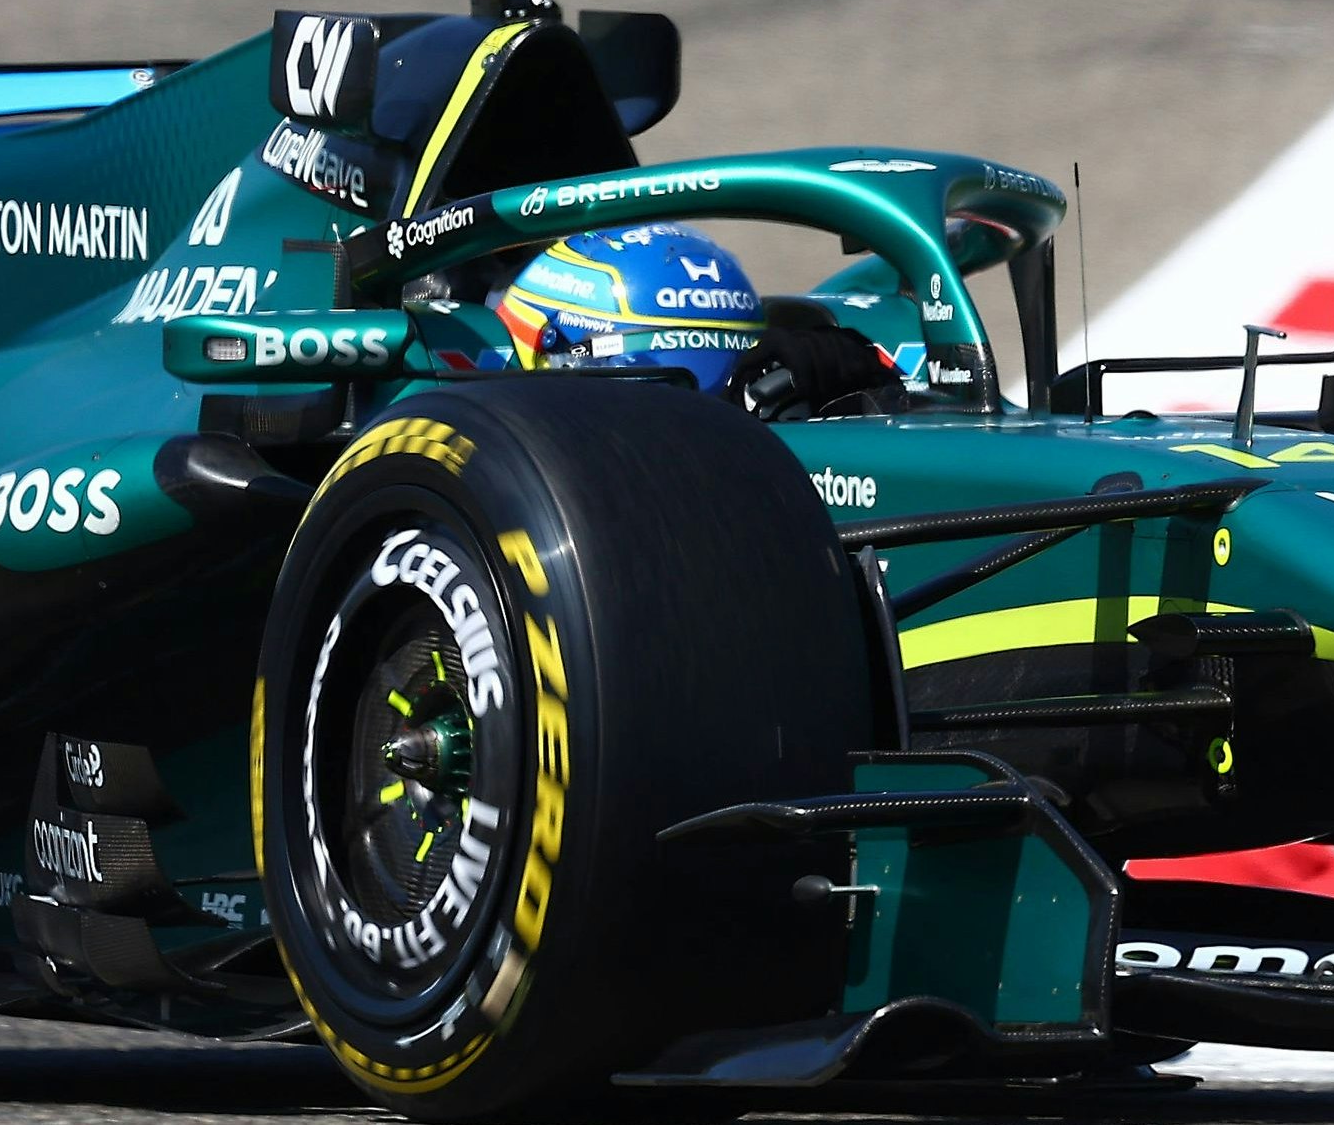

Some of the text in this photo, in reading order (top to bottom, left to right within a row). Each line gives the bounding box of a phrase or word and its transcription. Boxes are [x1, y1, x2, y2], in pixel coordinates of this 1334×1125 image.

[262, 116, 368, 208] CoreWeave
[556, 170, 721, 208] BREITLING
[48, 203, 148, 261] MARTIN
[405, 205, 474, 247] Cognition
[656, 287, 754, 311] aramco
[255, 328, 389, 367] BOSS
[650, 331, 719, 350] ASTON
[399, 542, 505, 719] CELSIUS
[496, 529, 572, 954] P ZERO
